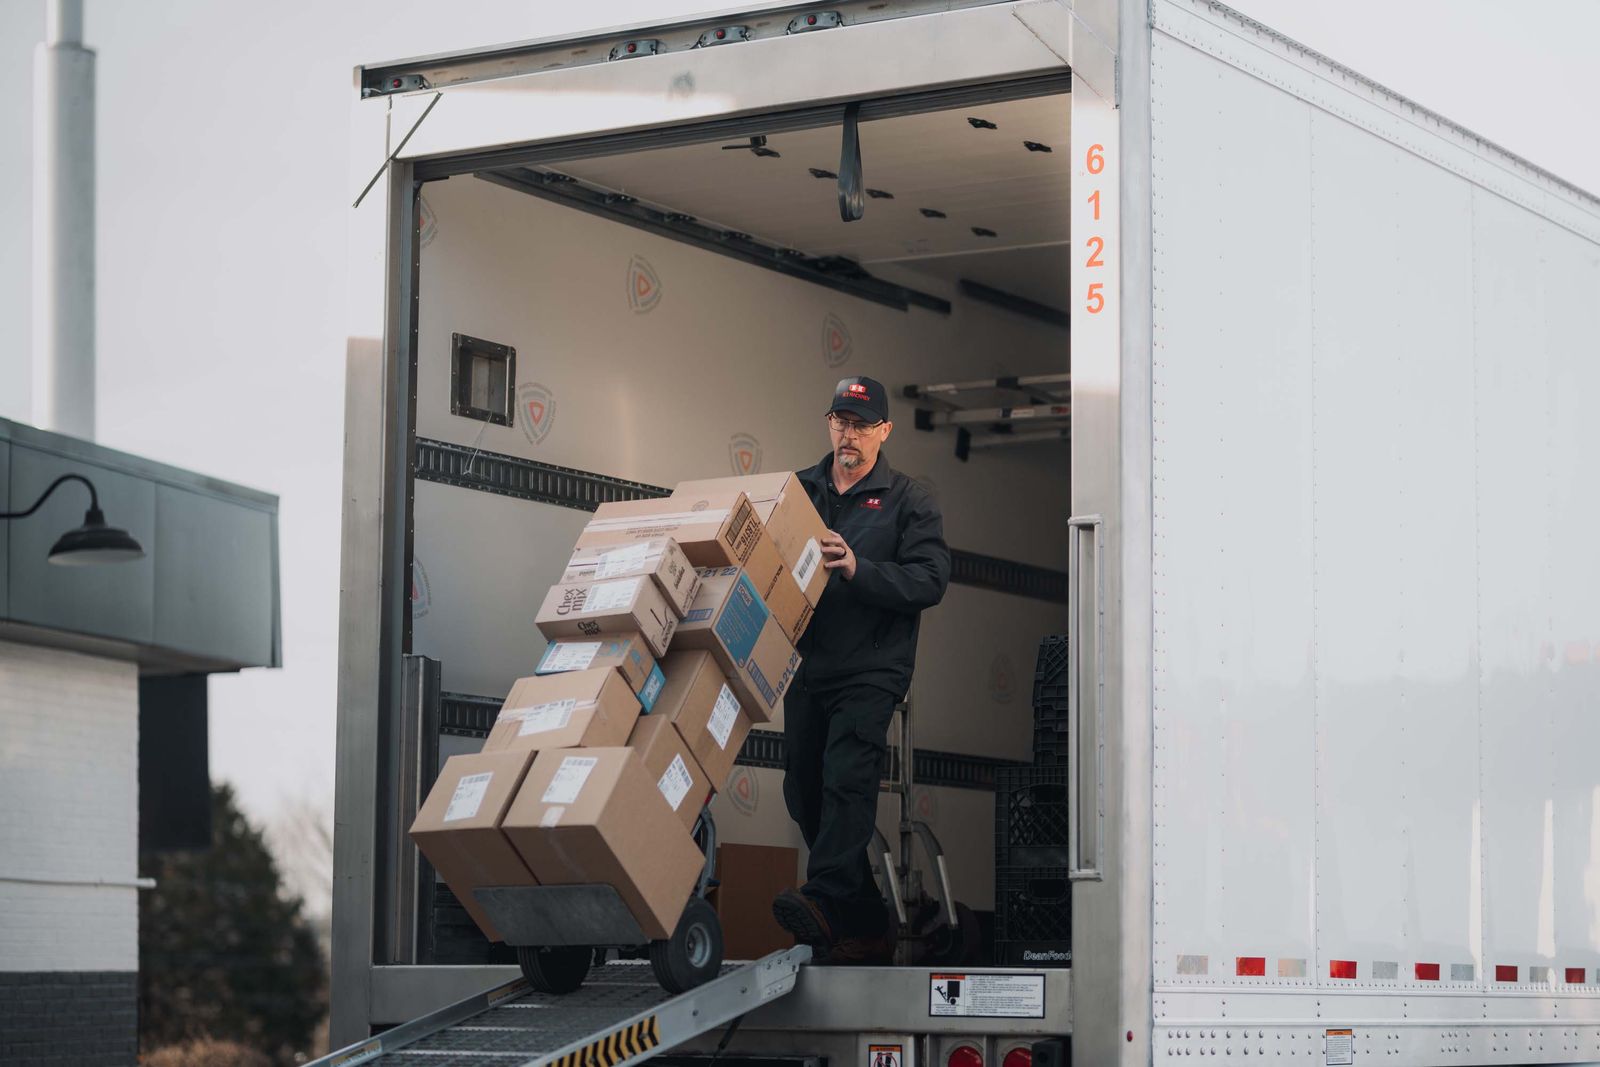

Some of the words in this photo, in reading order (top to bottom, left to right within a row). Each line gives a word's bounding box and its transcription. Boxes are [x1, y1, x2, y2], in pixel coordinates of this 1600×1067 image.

[1086, 143, 1105, 314] 6125
[702, 568, 718, 578] 21
[720, 567, 738, 577] 22
[556, 588, 575, 615] Chex
[572, 588, 588, 611] mix
[577, 619, 599, 631] Chex
[776, 681, 785, 696] 19
[789, 652, 799, 668] 22
